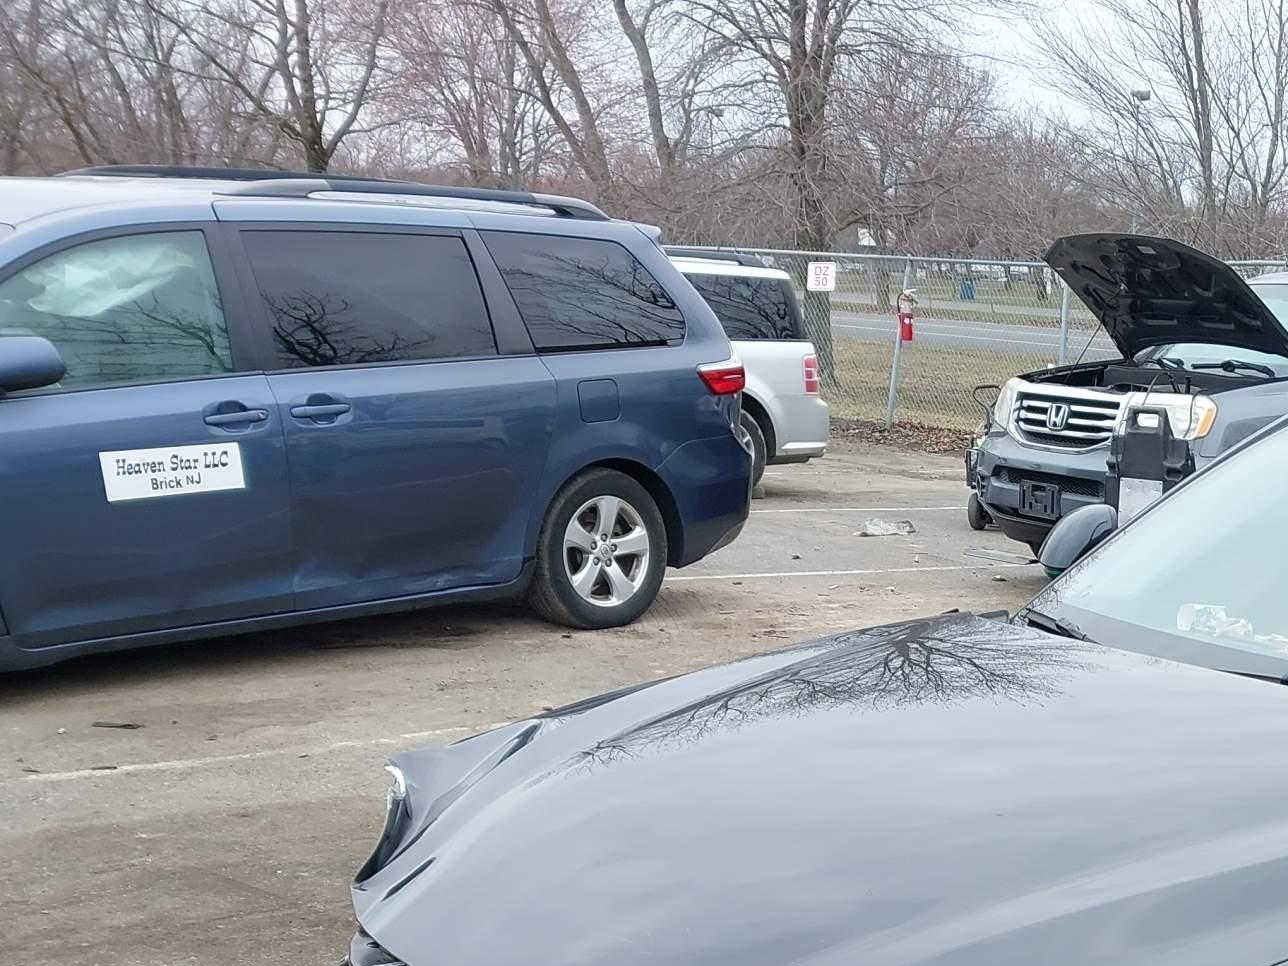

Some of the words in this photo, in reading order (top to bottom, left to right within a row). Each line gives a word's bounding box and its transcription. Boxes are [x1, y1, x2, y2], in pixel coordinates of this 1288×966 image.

[815, 265, 830, 276] DZ
[815, 276, 828, 287] 50
[115, 458, 166, 476] Heaven
[169, 453, 199, 472] Star
[203, 450, 229, 469] LLC
[150, 476, 183, 490] Brick
[186, 471, 201, 486] NJ
